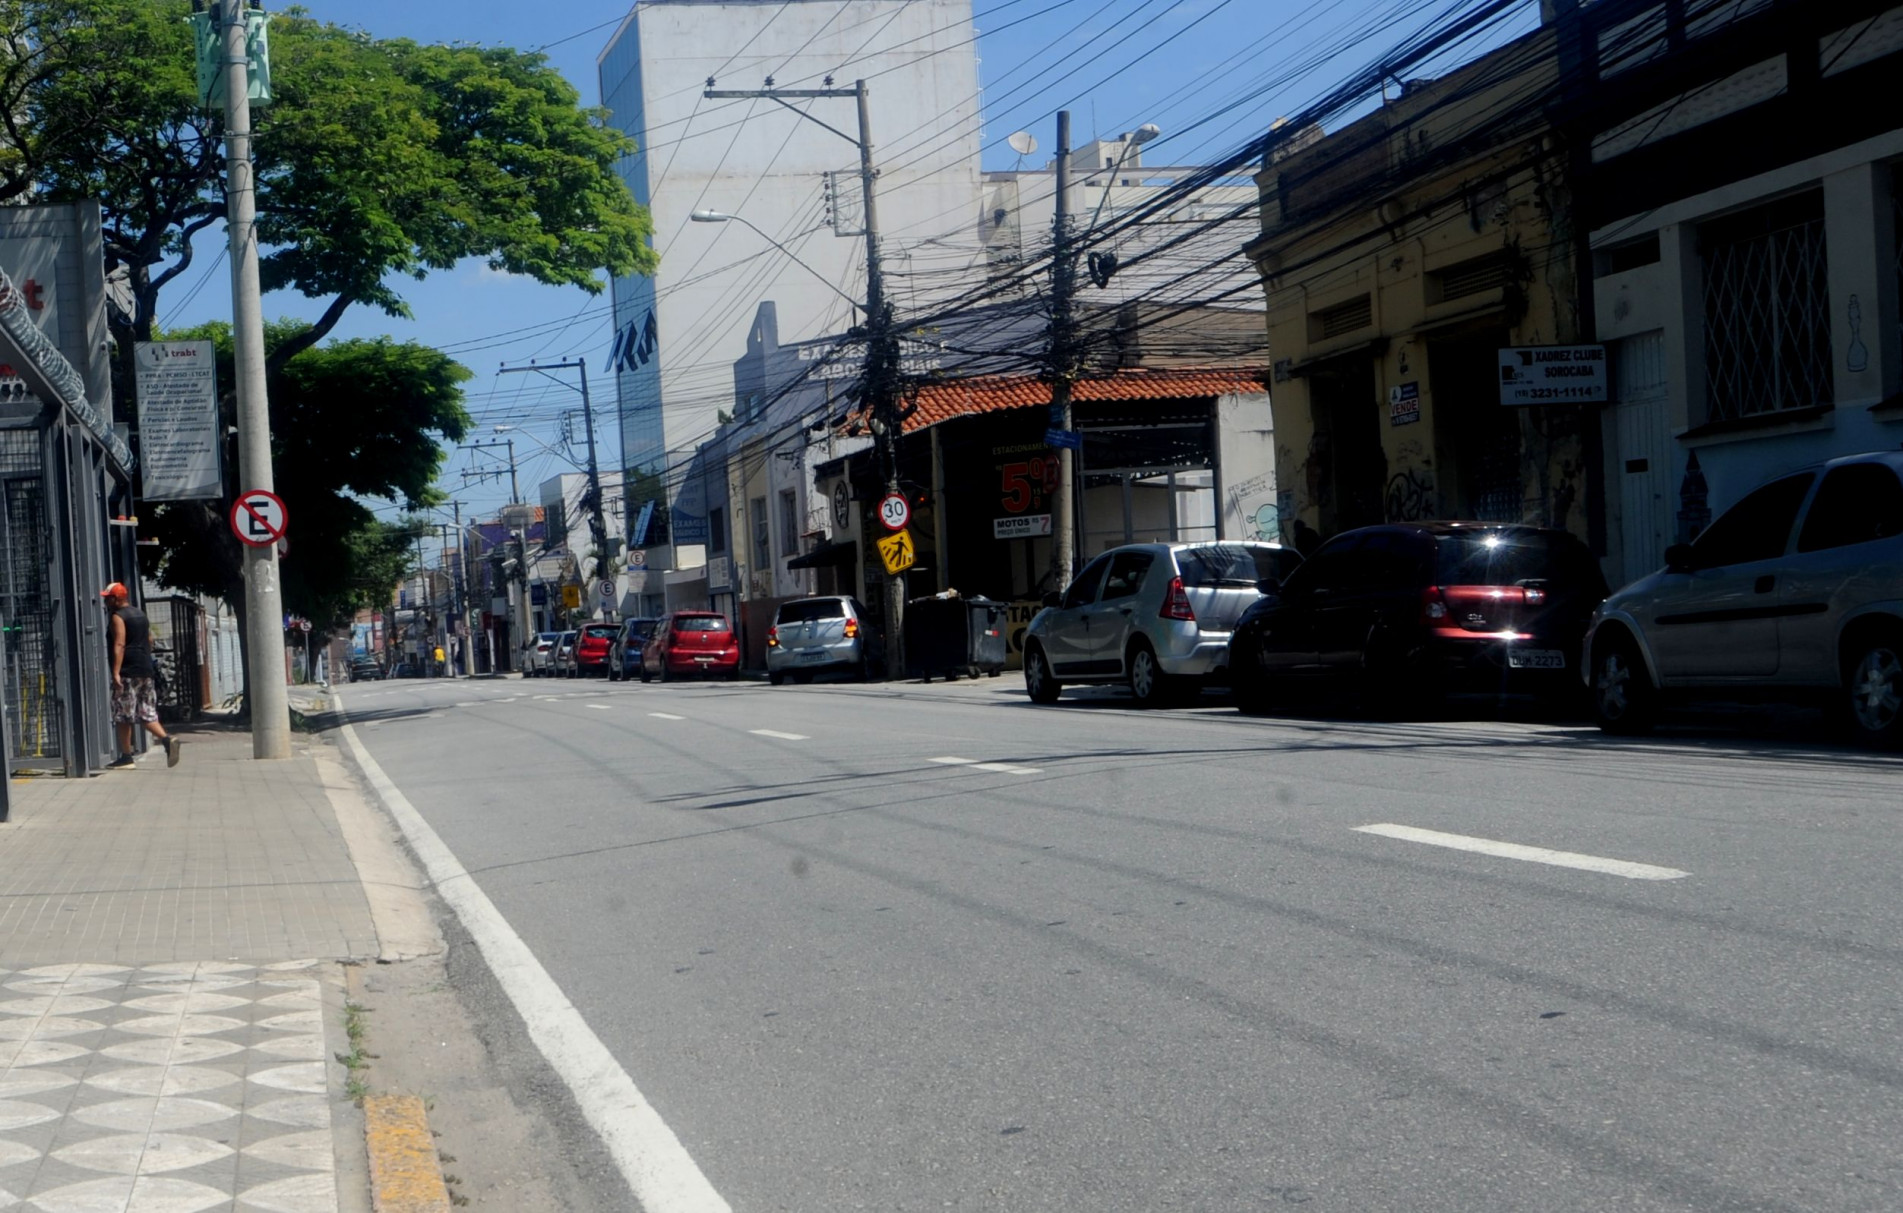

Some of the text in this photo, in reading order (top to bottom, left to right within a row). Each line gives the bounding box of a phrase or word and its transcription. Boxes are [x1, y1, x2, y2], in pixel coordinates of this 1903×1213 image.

[171, 349, 197, 358] trabt
[1535, 349, 1603, 362] XADREZ CLUBE
[1544, 366, 1594, 378] SOROCABA
[1530, 387, 1592, 399] 3231-1114
[1391, 399, 1417, 414] VENDE
[992, 441, 1048, 455] ESTACIONAMEN
[884, 501, 904, 518] 30
[248, 502, 270, 534] E
[997, 518, 1030, 528] MOTOS
[1040, 516, 1049, 534] 7
